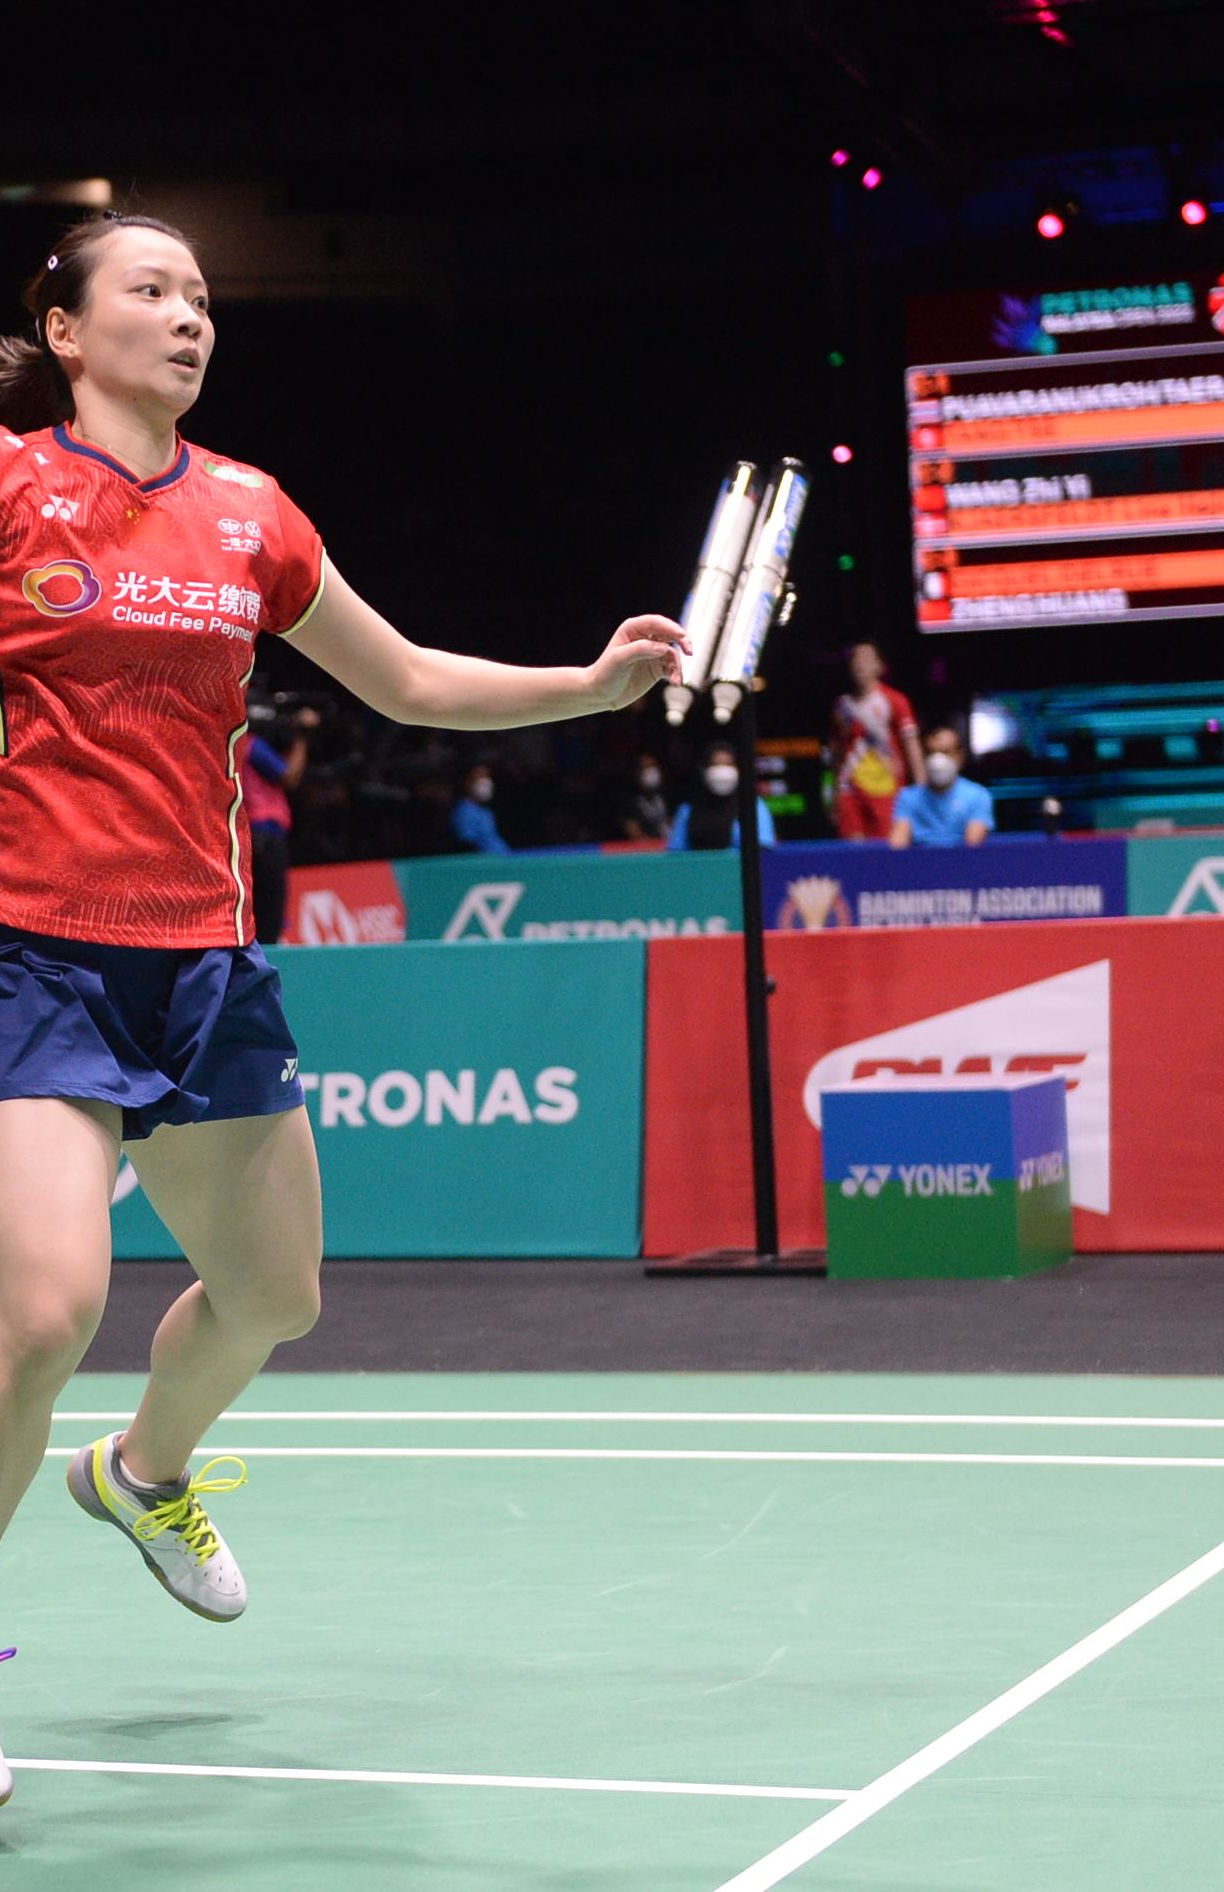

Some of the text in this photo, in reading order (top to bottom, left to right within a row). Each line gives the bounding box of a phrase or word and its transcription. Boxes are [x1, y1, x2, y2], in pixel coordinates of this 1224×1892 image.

[112, 571, 261, 625] 光大云缴费
[112, 605, 166, 626] Cloud
[169, 612, 205, 631] Fee
[859, 884, 1103, 918] BADMINTON ASSOCIATION
[898, 1163, 995, 1197] YONEX
